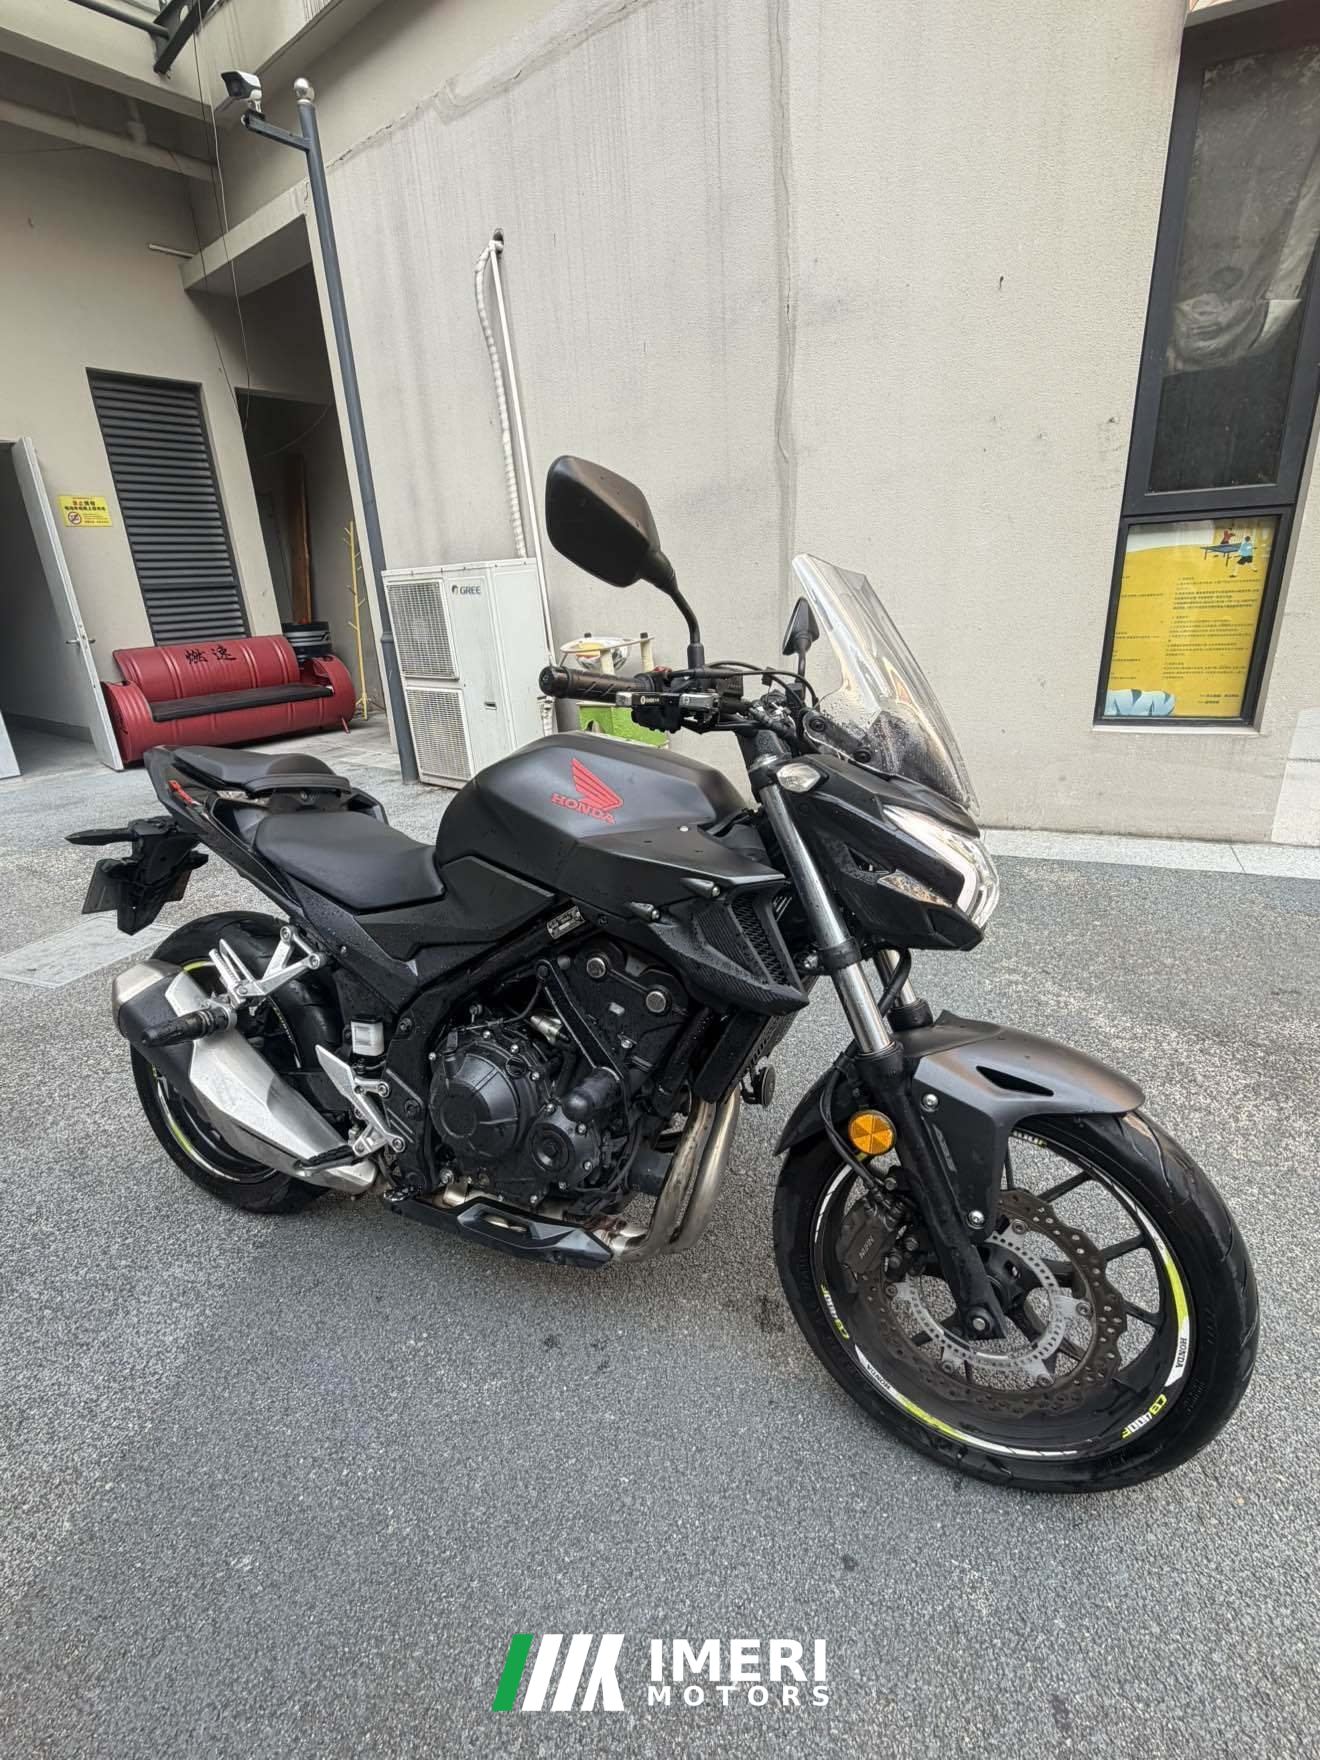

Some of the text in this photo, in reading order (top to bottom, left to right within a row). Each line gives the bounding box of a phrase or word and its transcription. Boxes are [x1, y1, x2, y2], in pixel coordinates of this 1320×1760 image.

[460, 585, 481, 595] GREE
[551, 792, 616, 824] HONDA
[1175, 1337, 1187, 1368] HONDA
